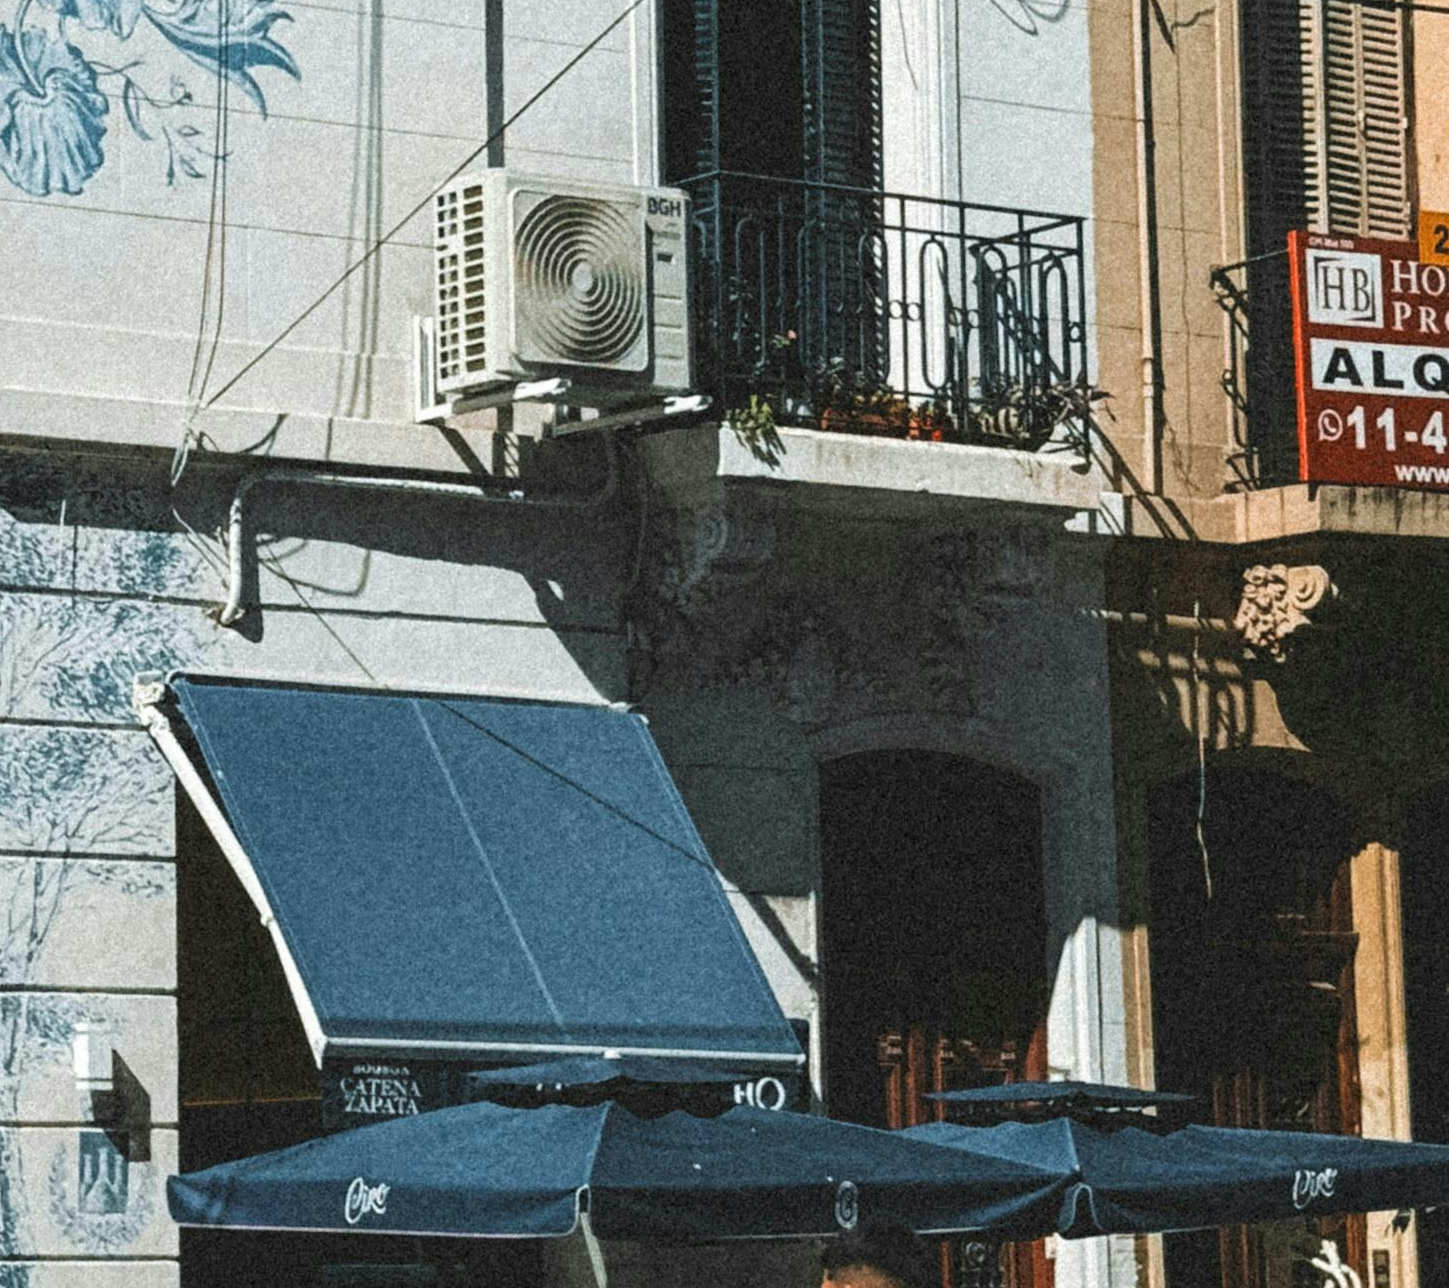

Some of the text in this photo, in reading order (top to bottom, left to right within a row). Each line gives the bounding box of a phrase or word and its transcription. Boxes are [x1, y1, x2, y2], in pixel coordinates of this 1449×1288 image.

[647, 196, 681, 217] BGH
[1320, 265, 1370, 312] HB
[1390, 259, 1449, 297] HO
[1392, 301, 1449, 334] PR
[1322, 347, 1449, 396] ALQ
[1347, 405, 1449, 454] 11-4
[340, 1077, 423, 1098] CATENA
[345, 1094, 419, 1115] ZAPATA
[345, 1177, 391, 1224] Ciro
